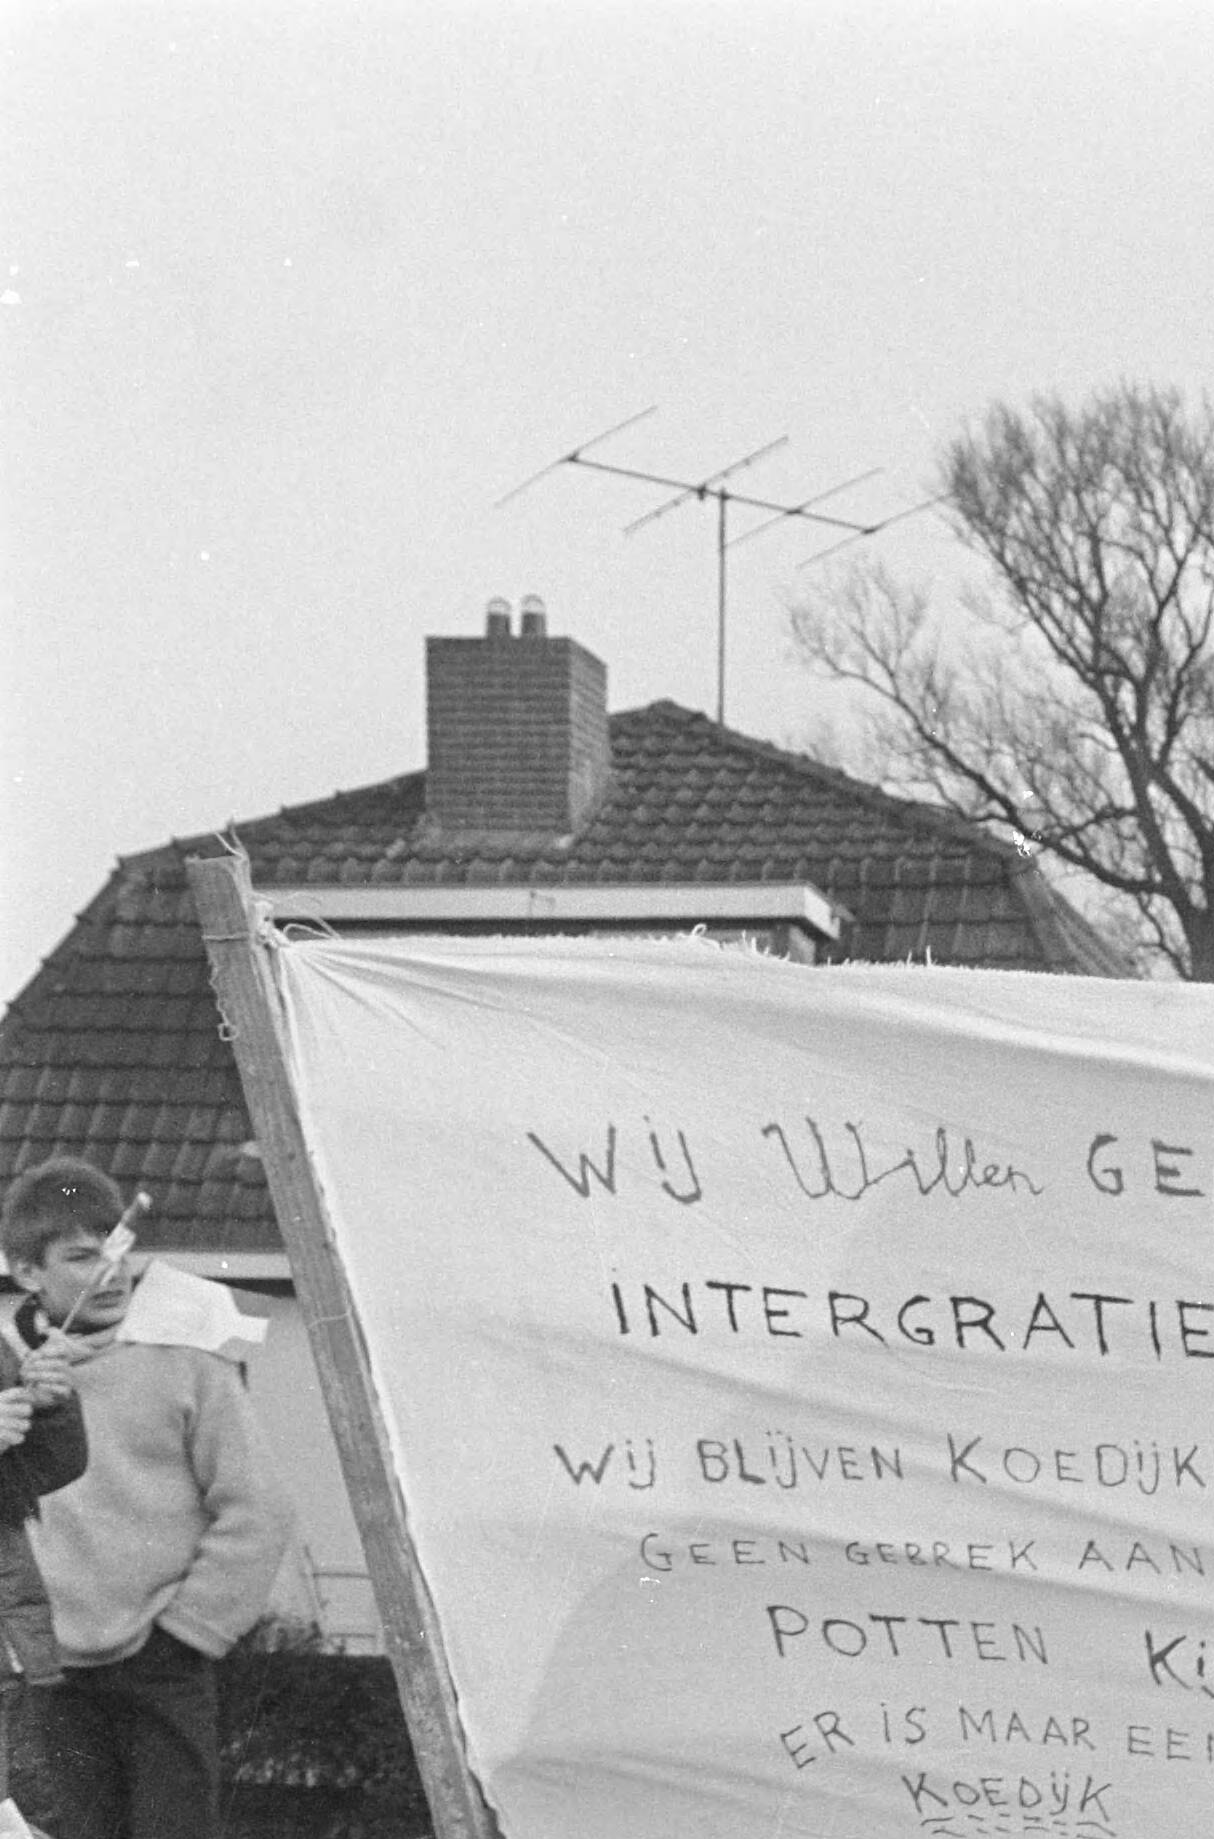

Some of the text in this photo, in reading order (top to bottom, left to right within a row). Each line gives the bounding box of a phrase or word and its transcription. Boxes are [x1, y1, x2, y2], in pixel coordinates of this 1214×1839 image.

[761, 1116, 1044, 1201] Willen
[640, 1533, 1205, 1576] GEEN GEBREK AAN
[766, 1604, 1048, 1665] POTTEN
[780, 1710, 855, 1770] ER
[958, 1706, 1096, 1751] MAAR
